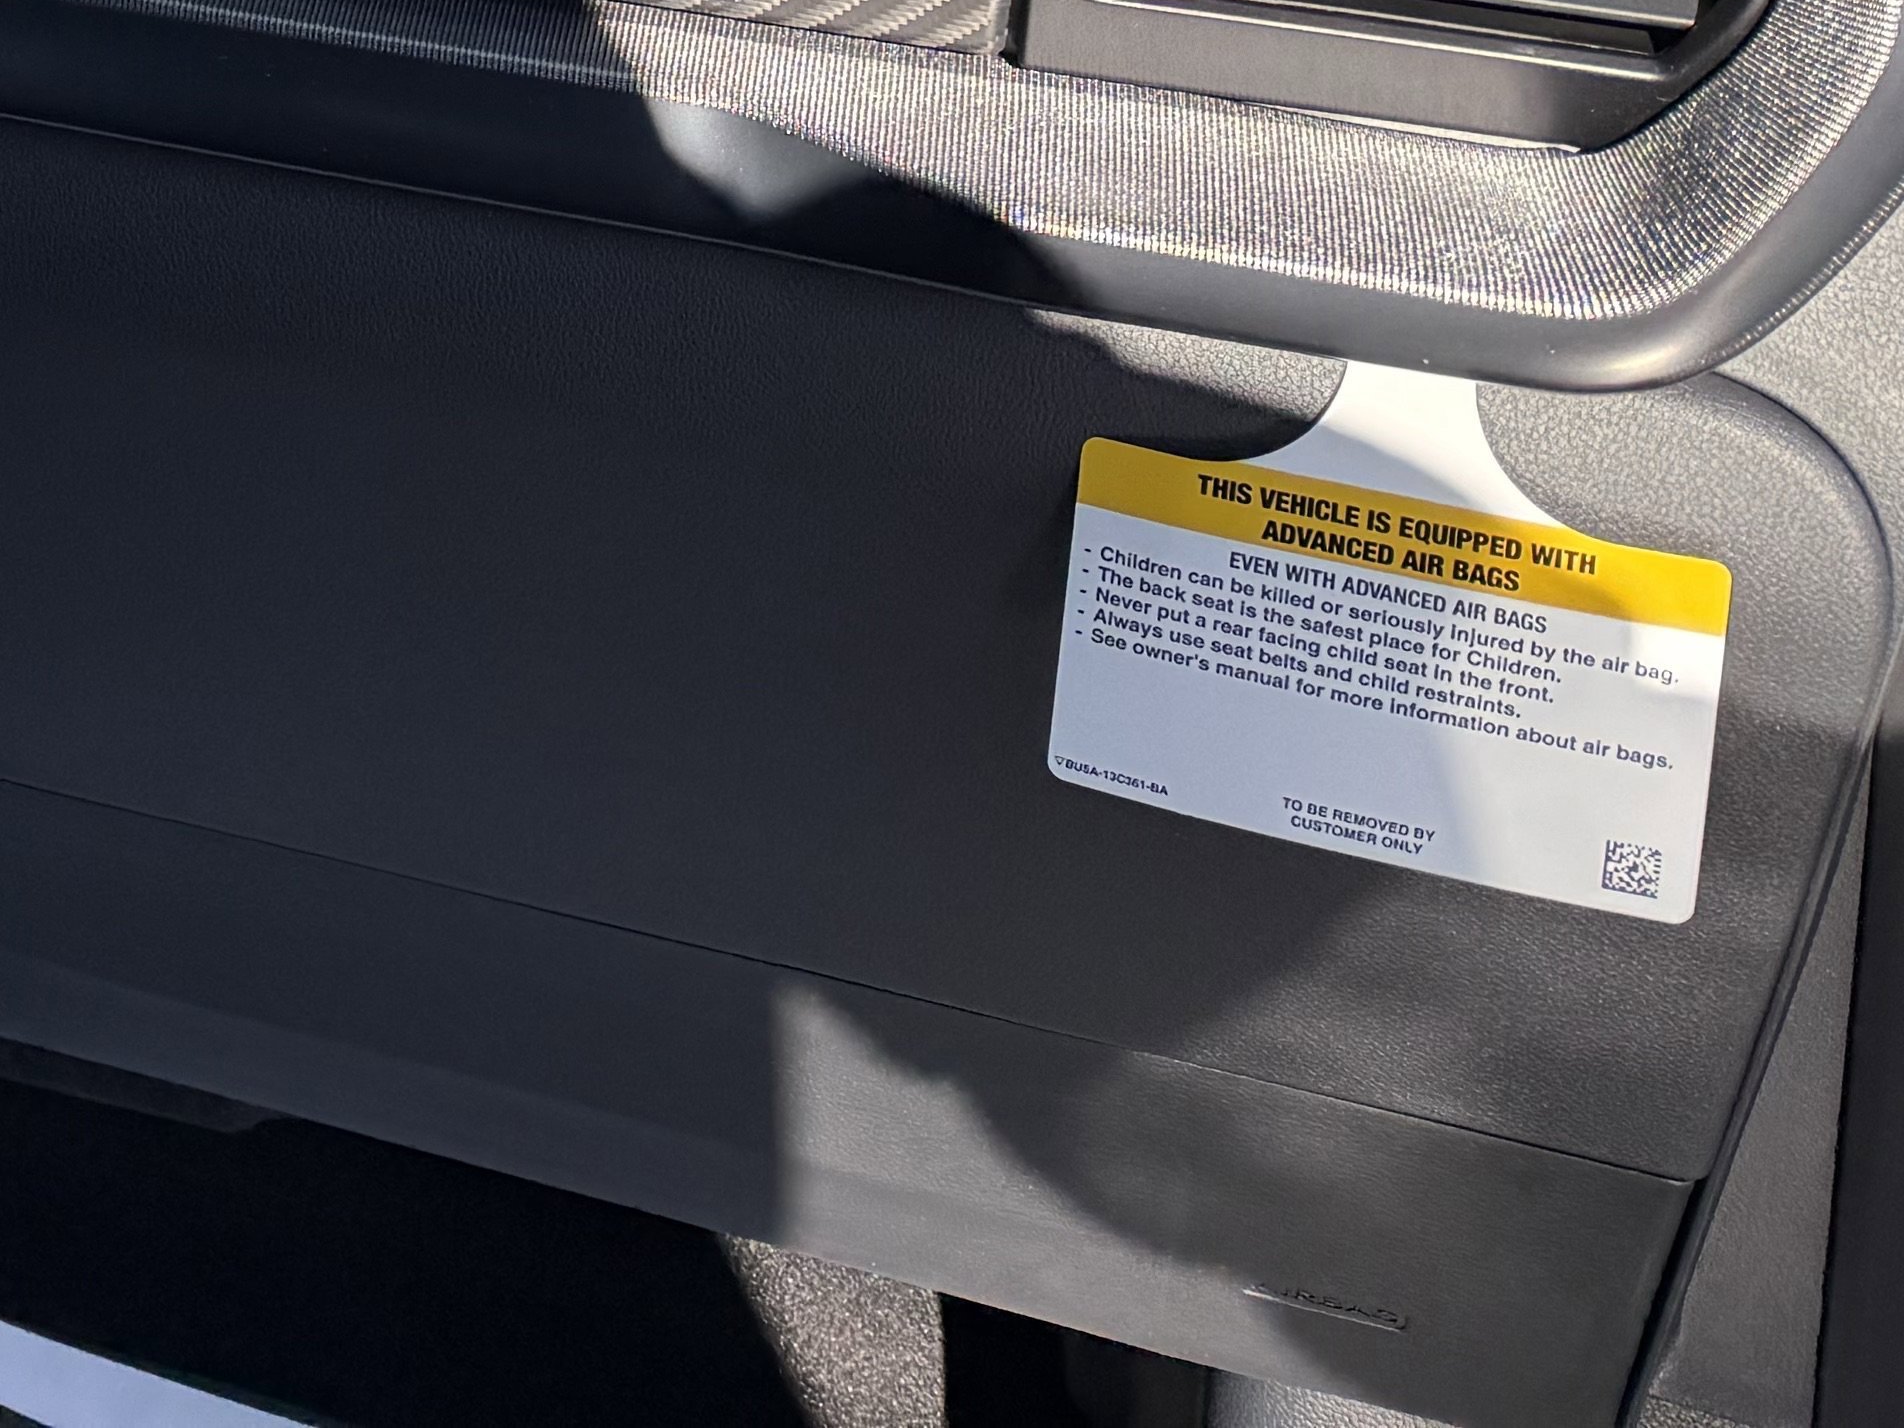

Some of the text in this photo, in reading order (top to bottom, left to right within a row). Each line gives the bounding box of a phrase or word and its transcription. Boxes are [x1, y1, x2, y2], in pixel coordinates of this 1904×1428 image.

[1198, 474, 1597, 575] THIS VEHICLE IS EQUIPPED WITH
[1261, 520, 1520, 592] ADVANCED AIR BAGS
[1095, 586, 1553, 703] Never put a rear facing child seat in the front.
[1098, 565, 1561, 683] The back seat is the safest place for Children.
[1100, 546, 1679, 685] Children can be killed or seriously injured by the air bag.
[1229, 551, 1547, 634] EVEN WITH ADVANCED AIR BAGS
[1091, 627, 1673, 770] See owner's manual for more information about air bags.
[1093, 608, 1521, 718] Always use seat belts and child restraints.
[1283, 796, 1435, 842] TO BE REMOVED BY
[1290, 815, 1423, 855] CUSTOMER ONLY
